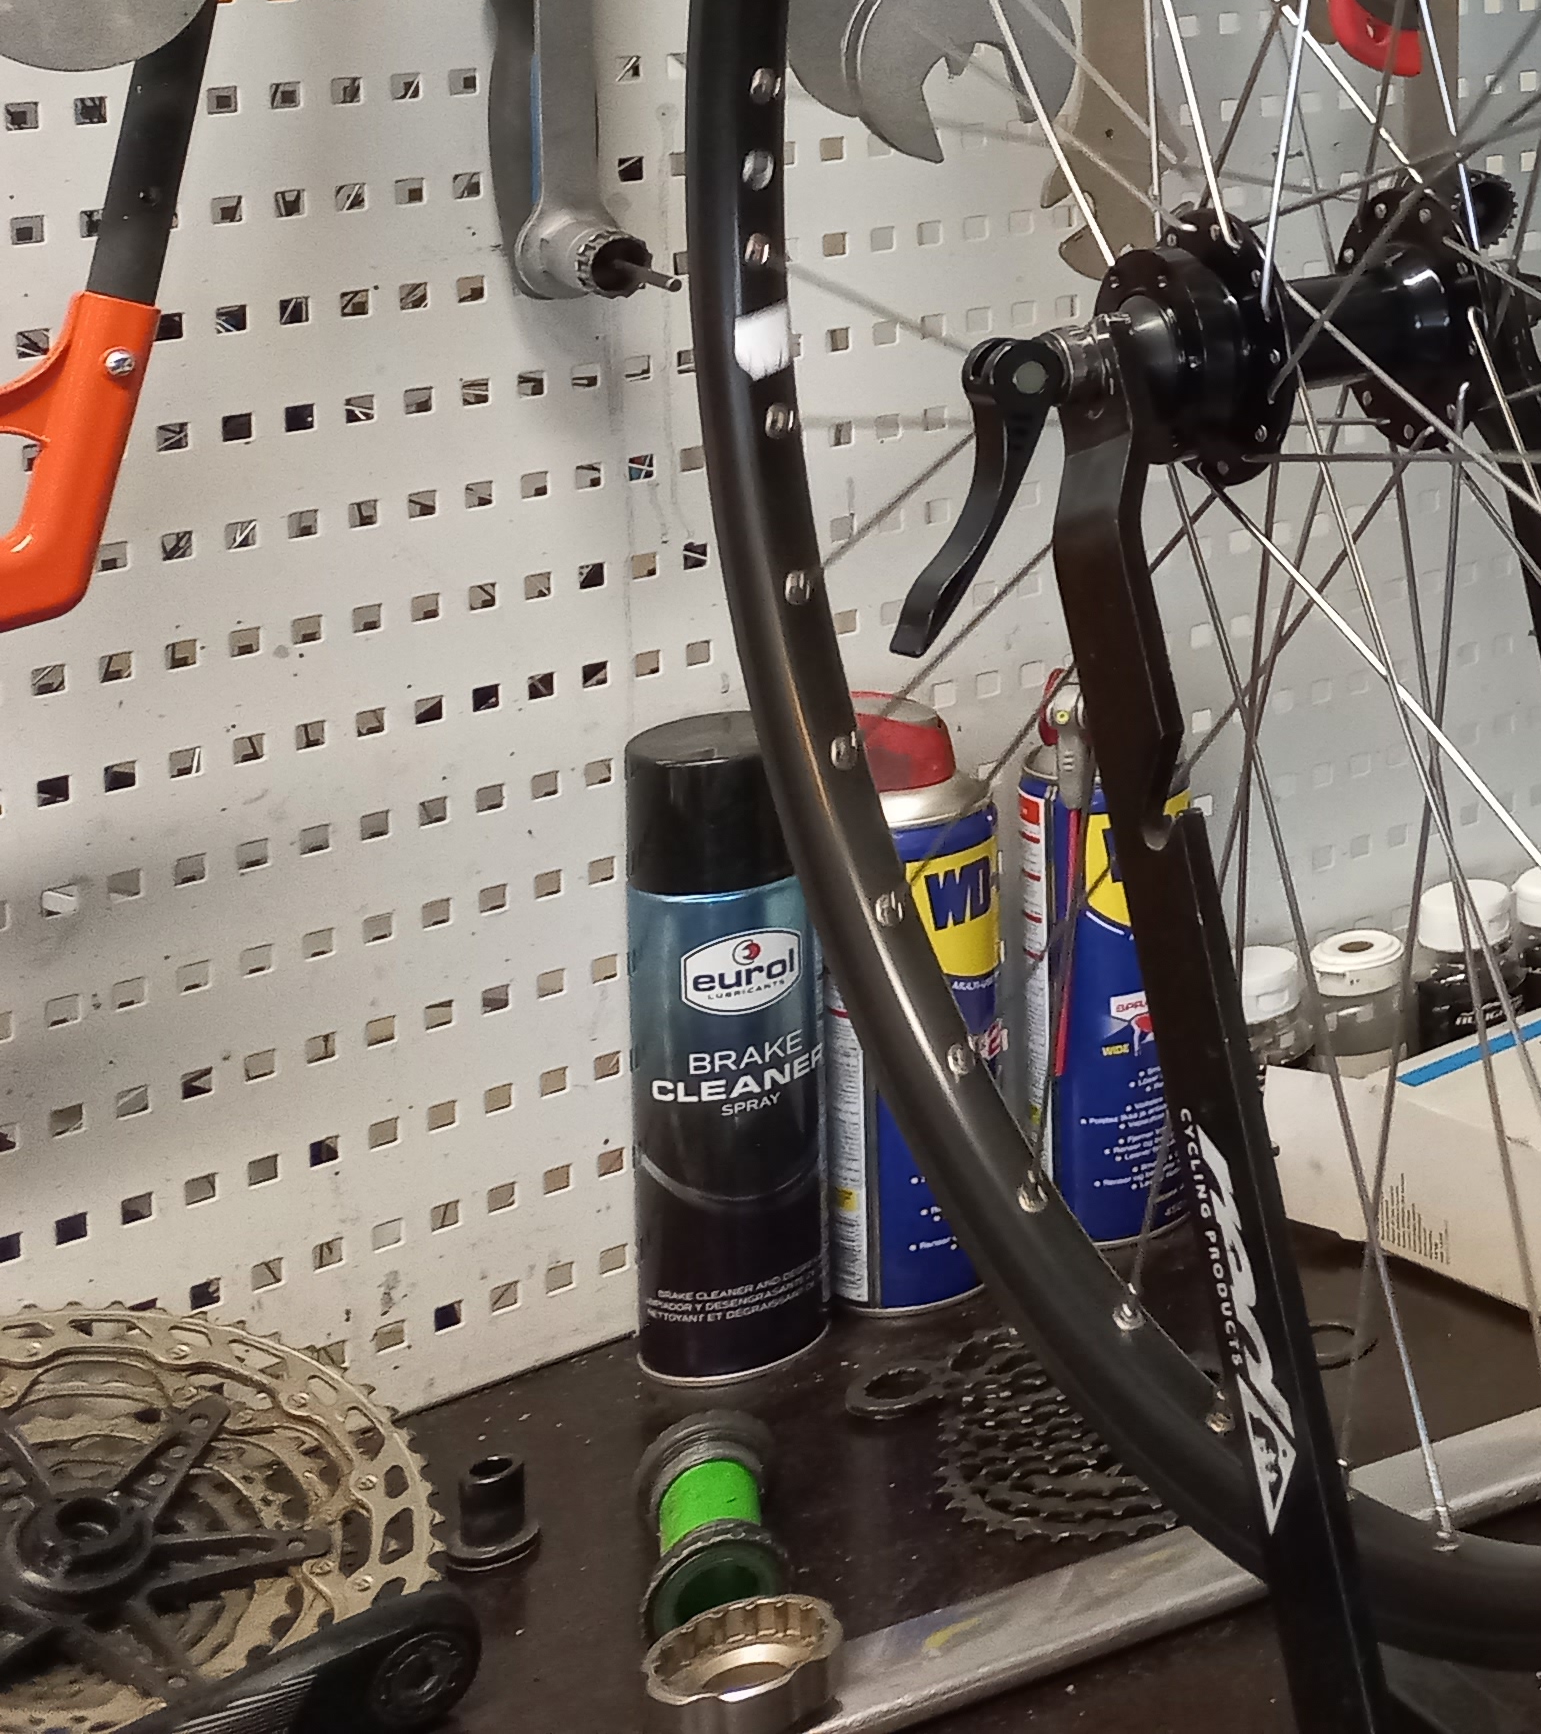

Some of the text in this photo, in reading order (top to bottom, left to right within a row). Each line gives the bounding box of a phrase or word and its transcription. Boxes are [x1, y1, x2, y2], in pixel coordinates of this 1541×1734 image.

[693, 948, 795, 993] eurol
[707, 979, 786, 1000] LUBRICANTS
[689, 1029, 804, 1075] BRAKE
[652, 1042, 824, 1103] CLEANER
[721, 1092, 782, 1116] SPRAY
[1179, 1108, 1242, 1366] CYCLING PRODUCTS
[658, 1289, 694, 1301] BRAKE
[696, 1284, 754, 1301] CLEANER
[707, 1312, 722, 1322] ET
